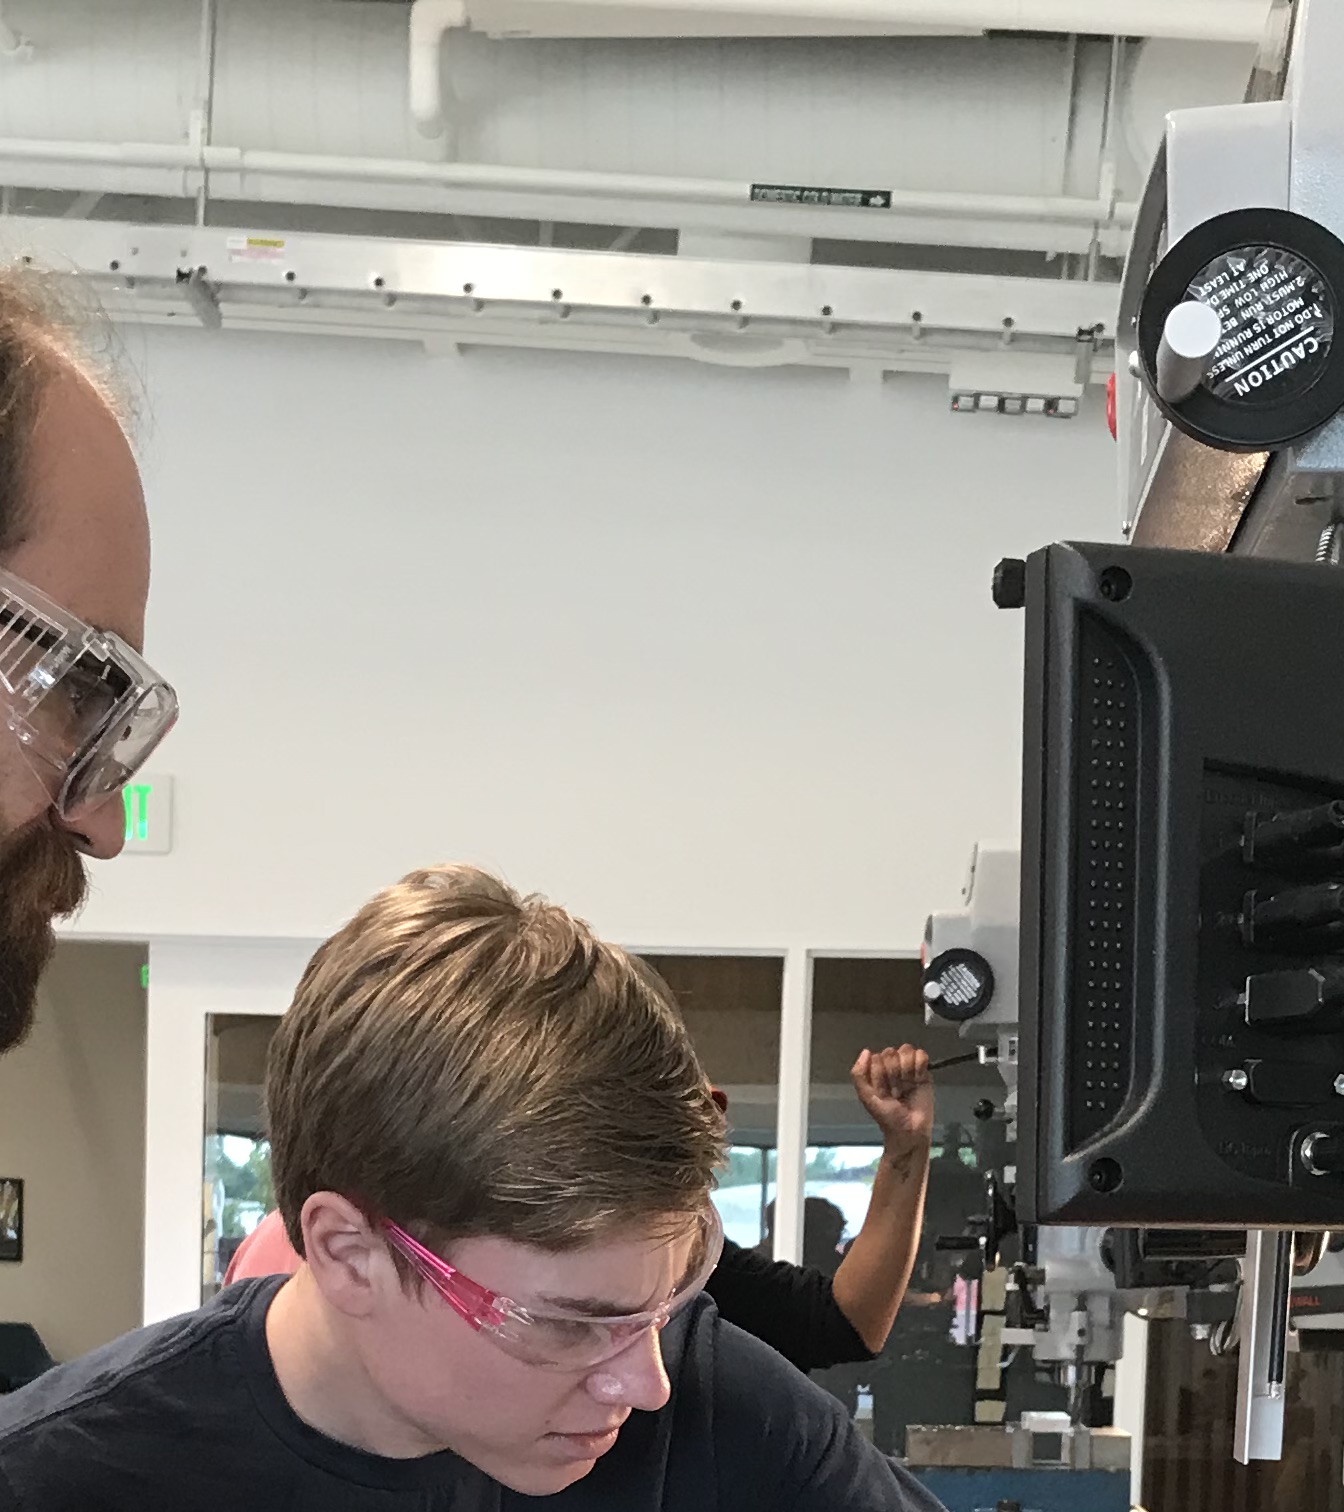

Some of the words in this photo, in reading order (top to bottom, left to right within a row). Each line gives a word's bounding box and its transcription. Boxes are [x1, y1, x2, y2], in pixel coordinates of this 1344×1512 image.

[1231, 263, 1246, 277] AT
[1248, 263, 1269, 282] ONE
[1260, 270, 1289, 291] HIGH
[1198, 272, 1231, 296] LEAST
[1220, 279, 1247, 300] TIME
[1234, 290, 1258, 309] LOW
[1241, 303, 1264, 321] RUN
[1266, 297, 1304, 325] MOTOR
[1252, 320, 1266, 334] IS
[1274, 320, 1295, 336] NOT
[1243, 333, 1273, 356] TURN
[1233, 337, 1319, 396] CAUTION
[122, 784, 152, 841] IT
